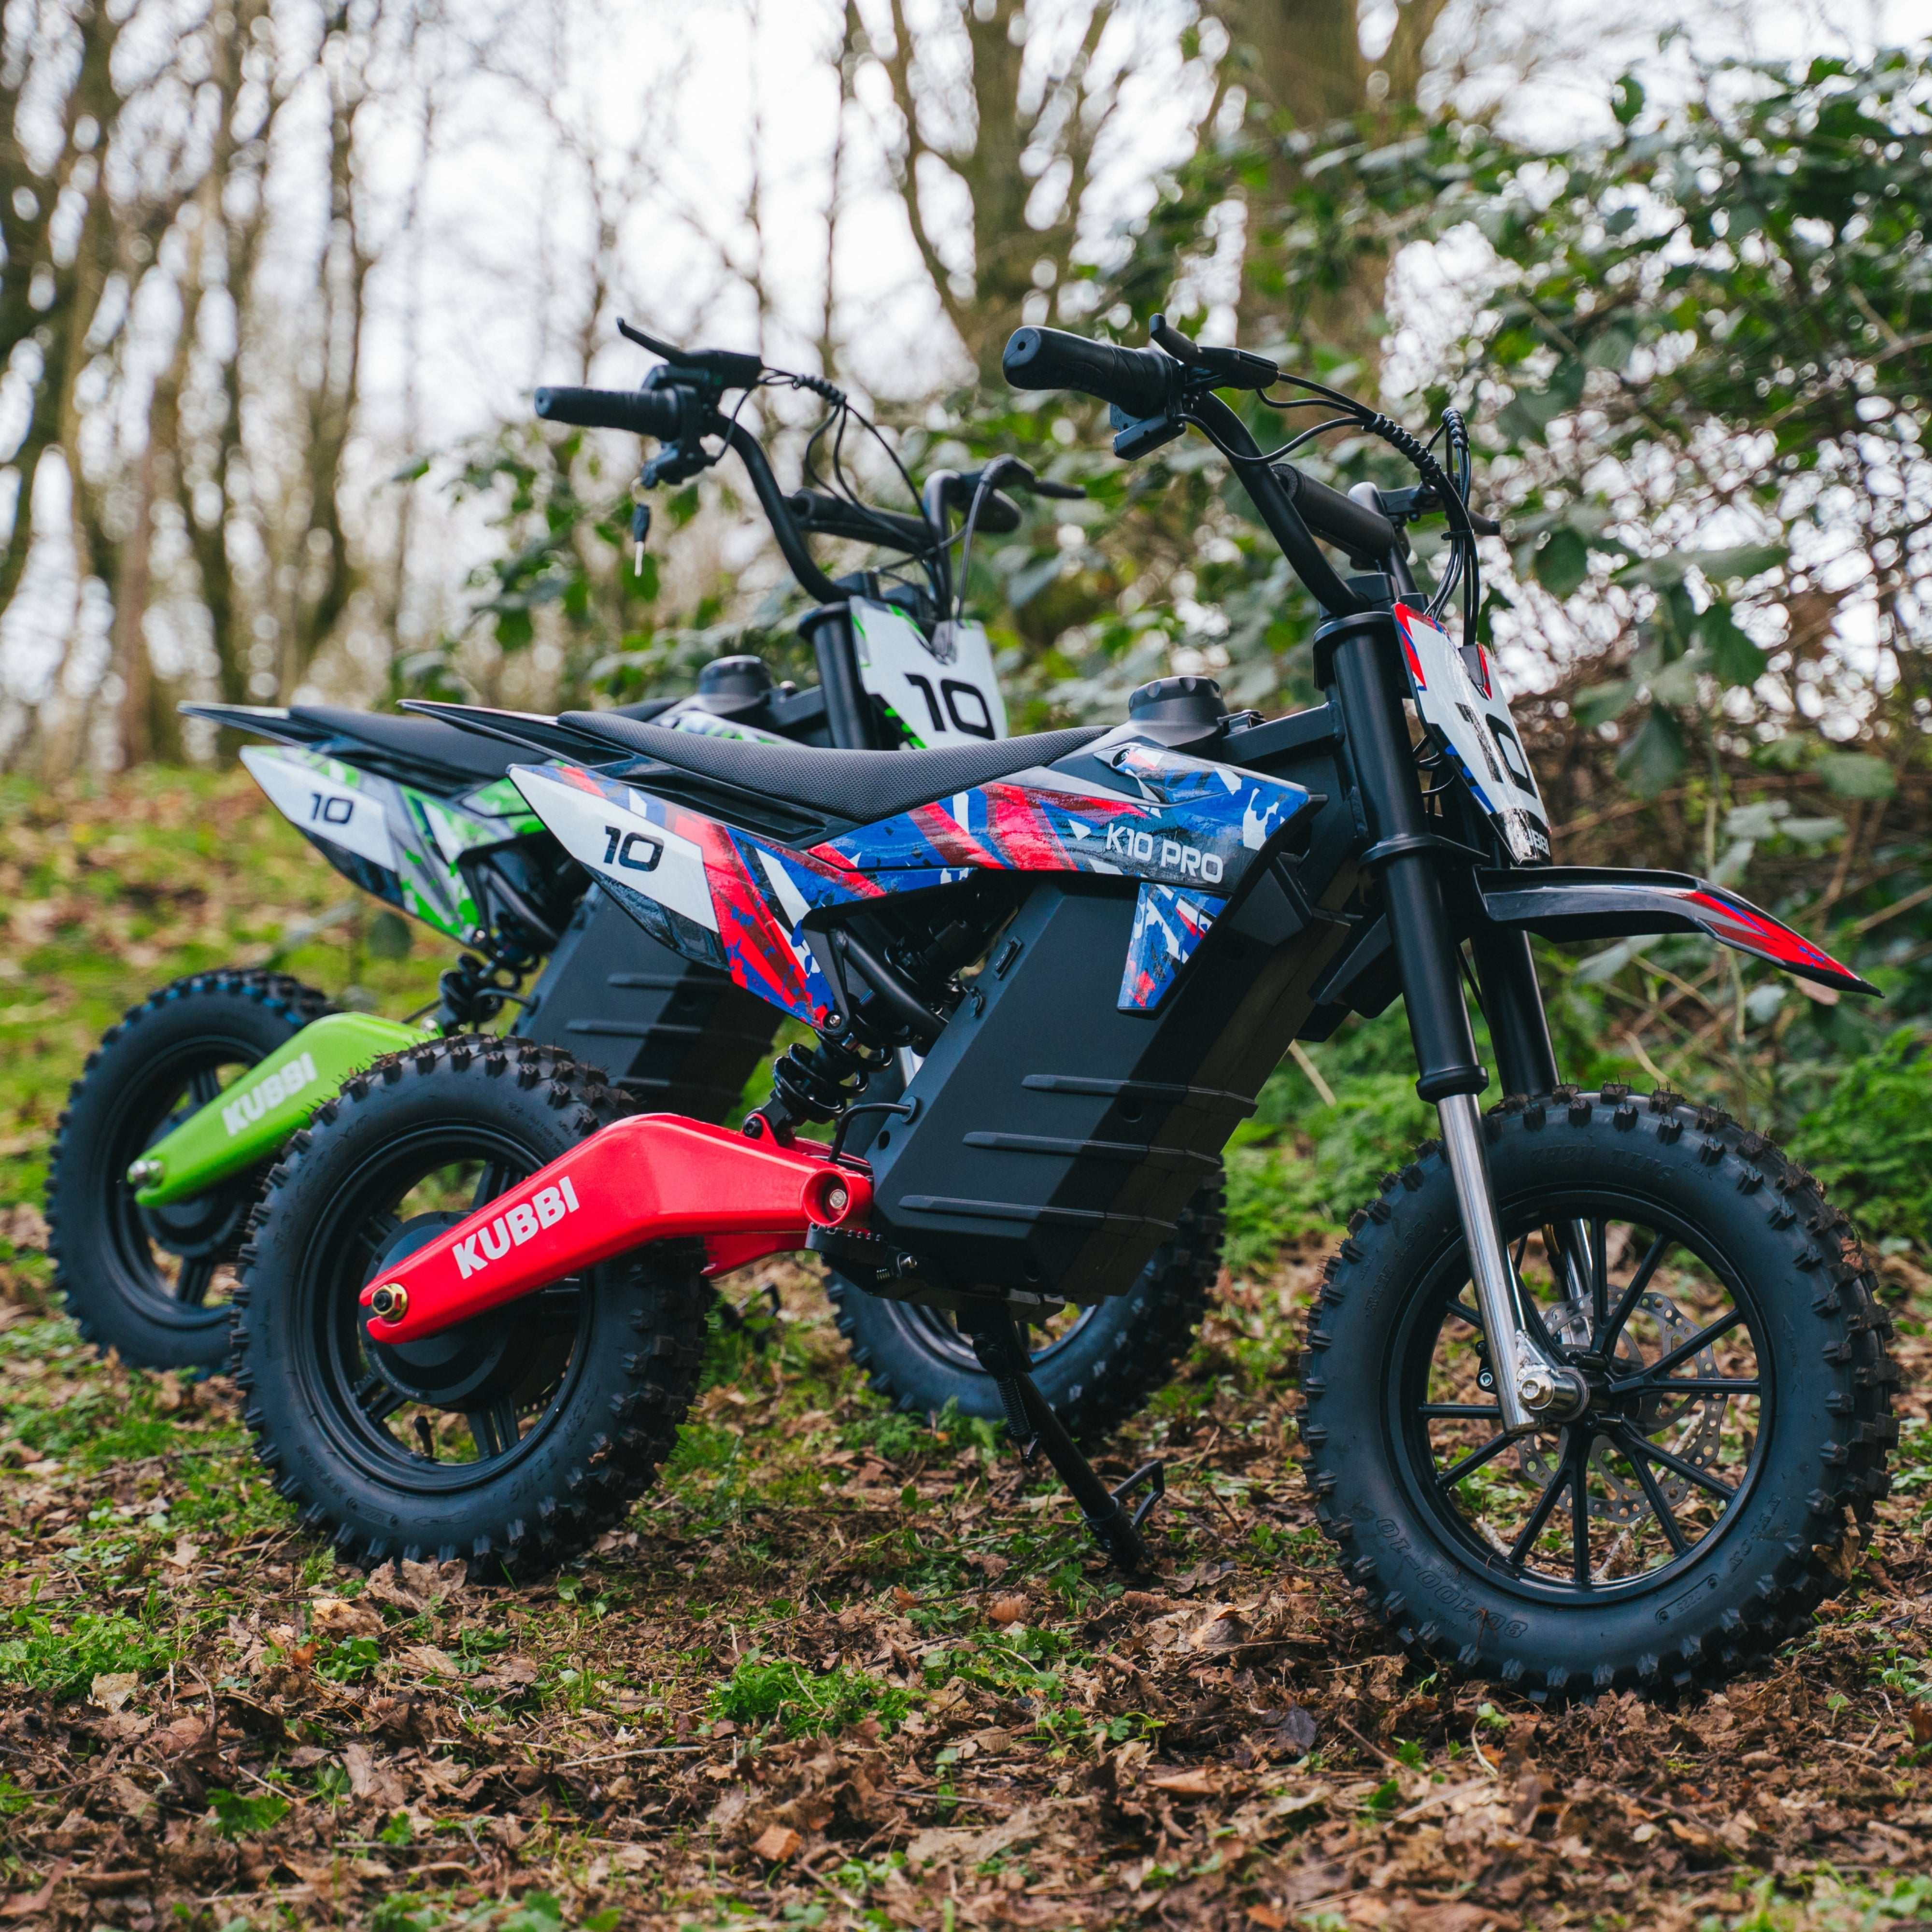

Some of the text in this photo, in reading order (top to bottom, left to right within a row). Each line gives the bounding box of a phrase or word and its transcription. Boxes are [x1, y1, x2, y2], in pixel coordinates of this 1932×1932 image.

[904, 673, 995, 740] 10
[1455, 702, 1538, 799] 10
[311, 793, 354, 824] 10
[603, 825, 665, 872] 10
[1106, 823, 1223, 883] K10 PRO
[222, 1051, 318, 1136] KUBBI
[452, 1176, 580, 1280] KUBBI
